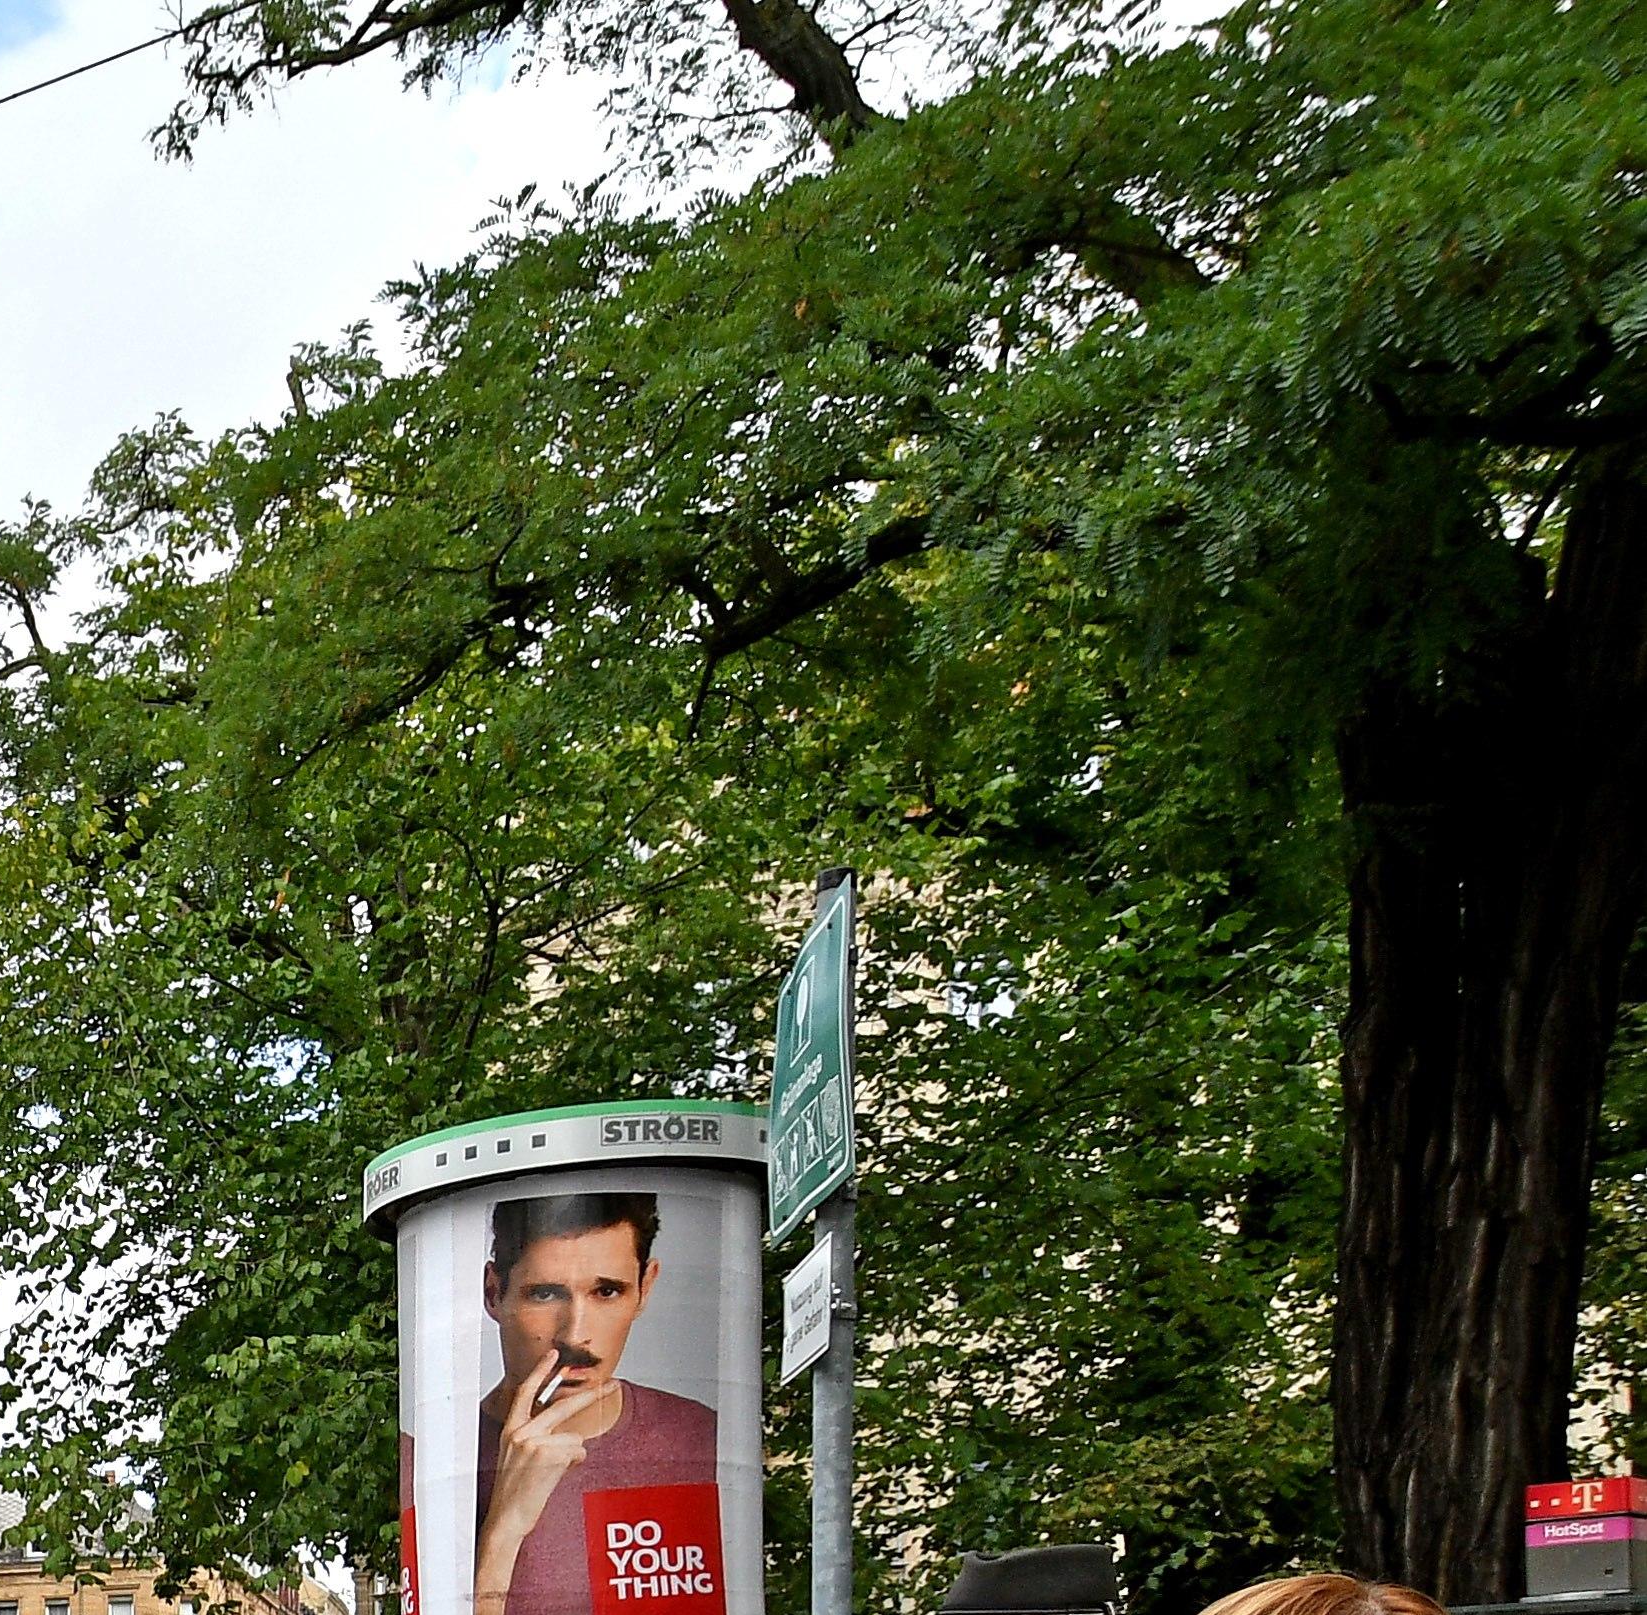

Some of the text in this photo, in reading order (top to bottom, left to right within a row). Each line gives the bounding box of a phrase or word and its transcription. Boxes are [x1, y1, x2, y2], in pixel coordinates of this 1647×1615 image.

[603, 1115, 720, 1143] STRÖER
[607, 1520, 661, 1548] DO
[1544, 1522, 1604, 1537] HotSpot
[607, 1546, 704, 1576] YOUR
[609, 1572, 713, 1600] THING
